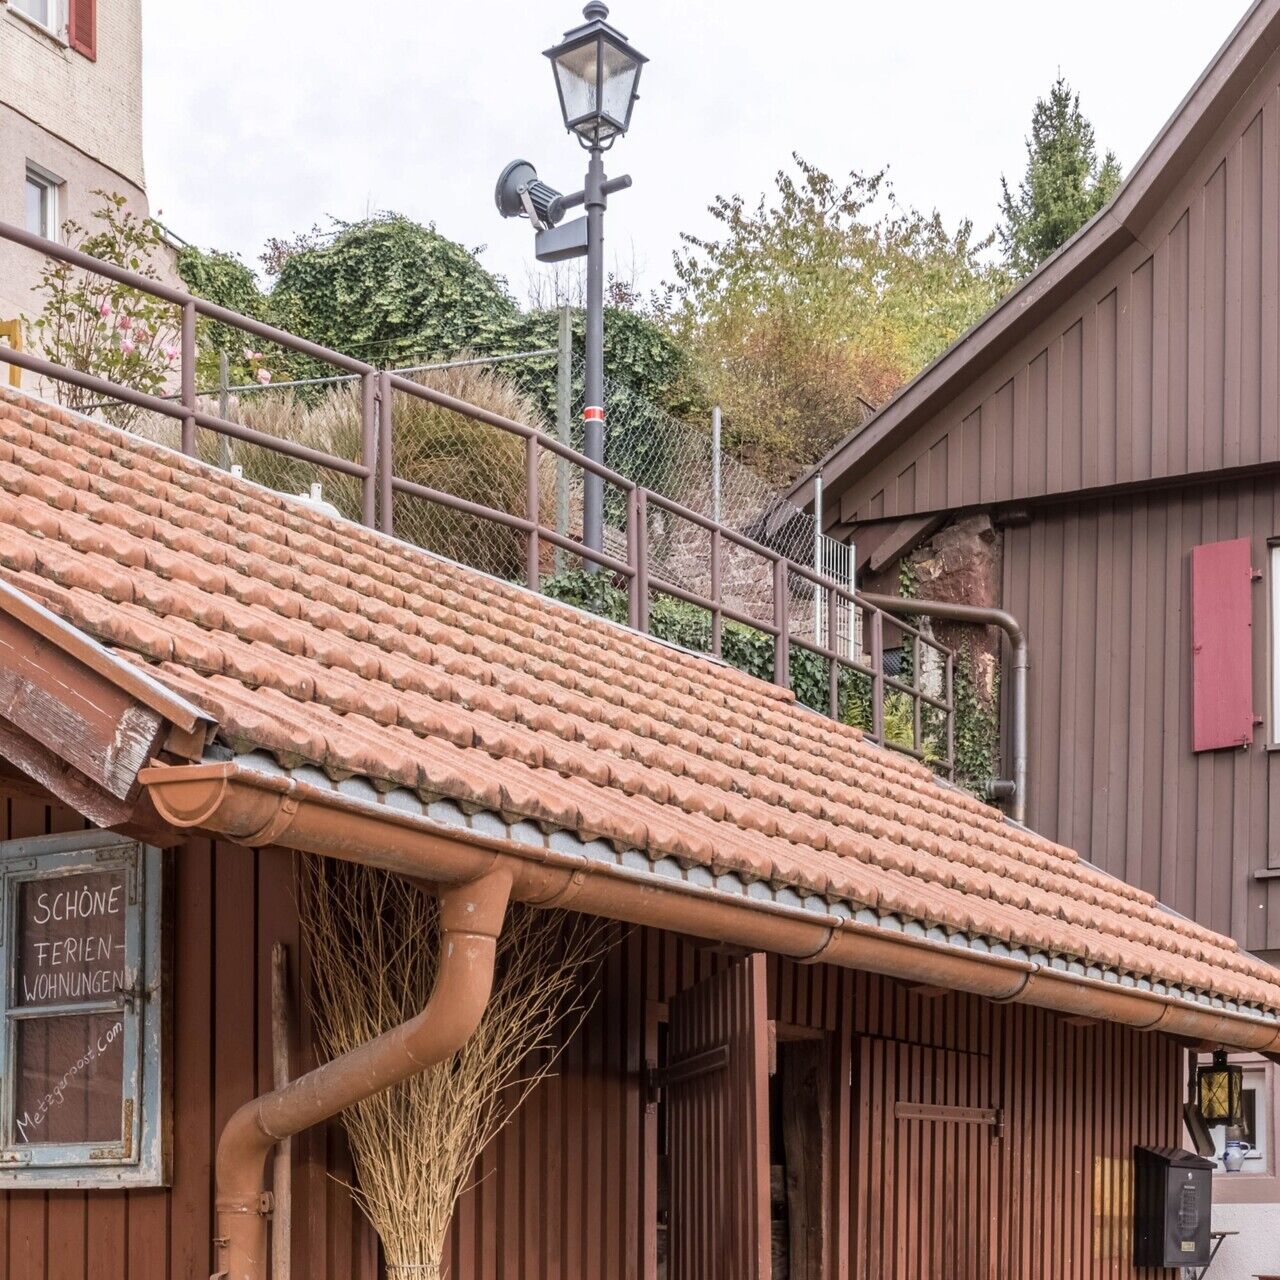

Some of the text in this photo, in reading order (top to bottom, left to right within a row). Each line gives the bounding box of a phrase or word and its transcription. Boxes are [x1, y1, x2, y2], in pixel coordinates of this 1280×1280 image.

[33, 885, 122, 925] SCHÖNE
[33, 933, 126, 967] FERIEN-
[23, 969, 124, 1002] WOHNUNGEN
